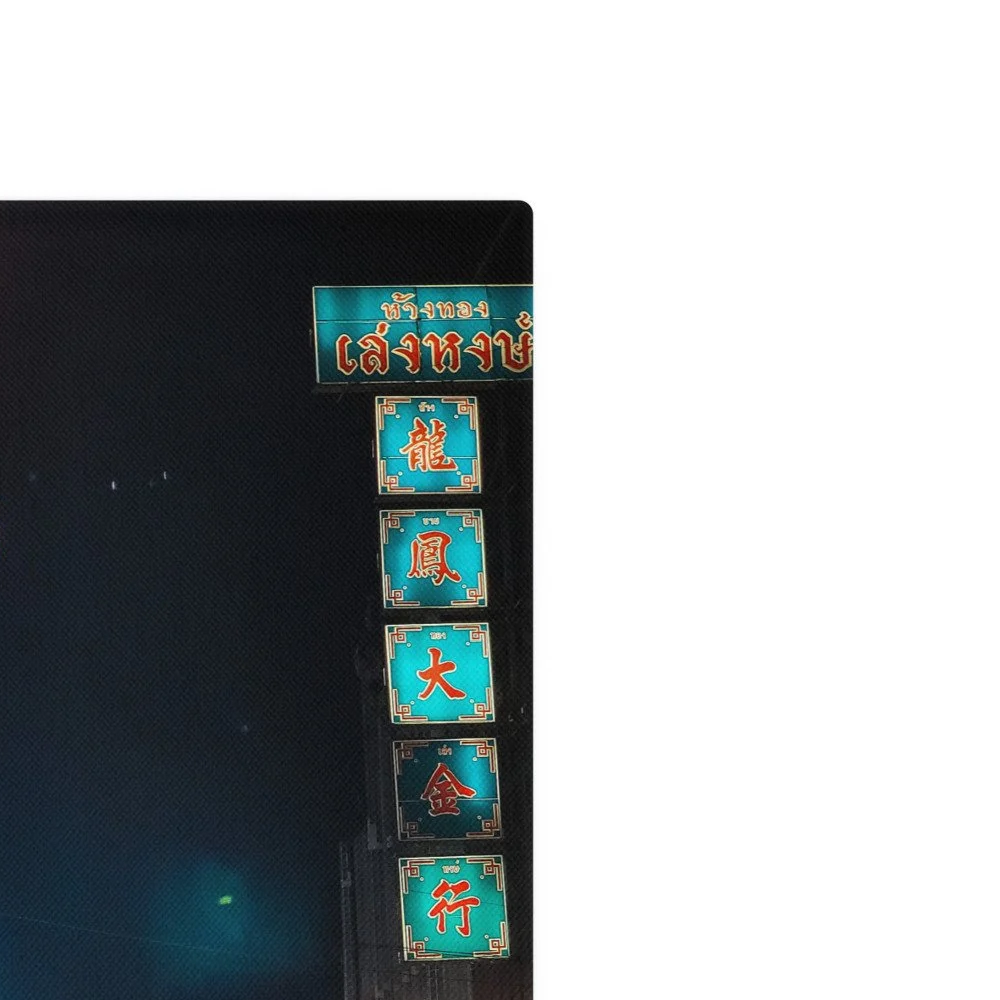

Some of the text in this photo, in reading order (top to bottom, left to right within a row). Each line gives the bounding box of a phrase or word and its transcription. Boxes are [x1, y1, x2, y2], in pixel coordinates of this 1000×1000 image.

[381, 292, 489, 320] ห้างทอง
[399, 417, 481, 938] 龍鳳大金行
